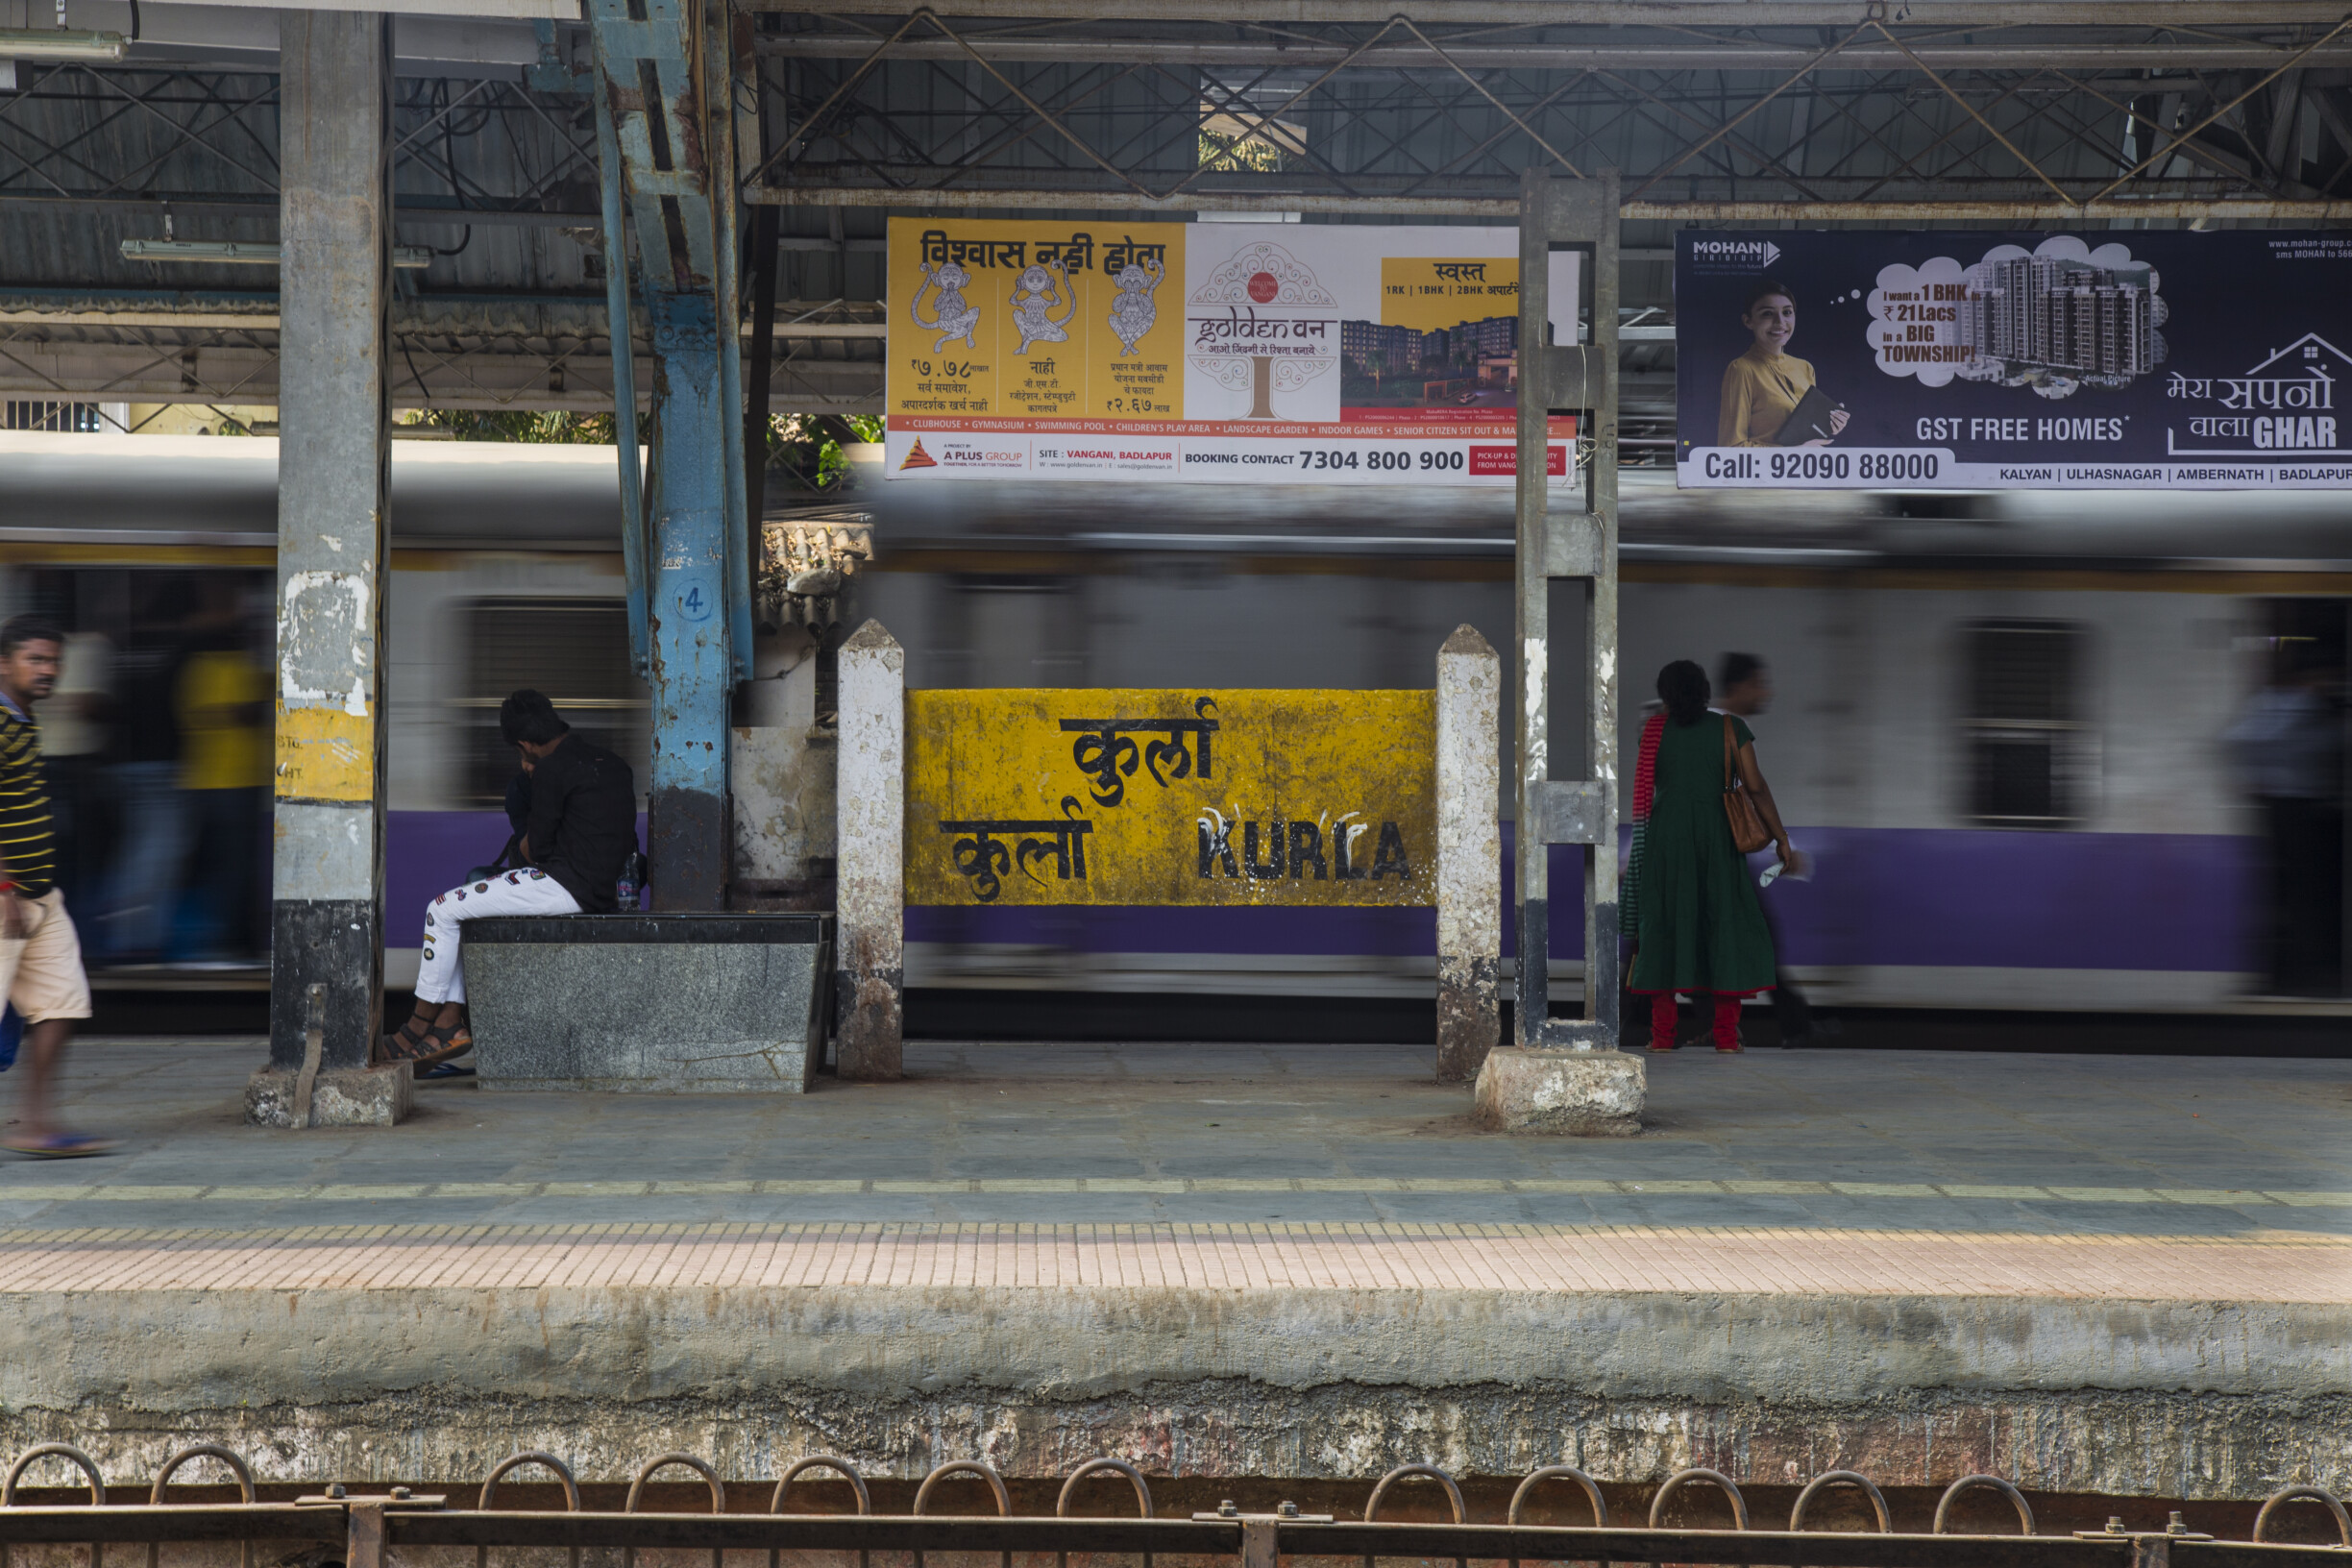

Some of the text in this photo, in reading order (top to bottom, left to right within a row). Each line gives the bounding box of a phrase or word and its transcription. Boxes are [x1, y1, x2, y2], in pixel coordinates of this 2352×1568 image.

[1694, 241, 1762, 254] MOHAN
[2268, 239, 2352, 248] www.mohan-group.c
[920, 230, 1026, 268] विश्वास
[1103, 235, 1165, 276] होता
[2294, 250, 2325, 258] MOHAN
[2338, 250, 2352, 258] 566
[1433, 263, 1487, 282] स्वस्त
[1386, 285, 1405, 294] 1RK
[1418, 285, 1444, 294] 1BHK
[1457, 285, 1483, 294] 2BHK
[1883, 283, 1981, 302] I want a 1 BHK in
[1898, 304, 1916, 322] 21
[1919, 304, 1957, 322] Lacs
[1291, 320, 1337, 338] वन
[1883, 325, 1935, 342] in a BIG
[1208, 343, 1231, 355] आओ
[1260, 343, 1267, 355] से
[1269, 344, 1291, 355] रिश्ता
[1883, 345, 1975, 362] TOWNSHIP!
[1029, 357, 1056, 375] नाही
[918, 380, 932, 393] सर्व
[2167, 364, 2336, 409] मेरा सपनों
[948, 398, 967, 411] खर्च
[968, 399, 989, 411] नाही
[913, 419, 962, 429] CLUBHOUSE
[971, 420, 1024, 429] GYMNASIUM
[1035, 421, 1082, 430] SWIMMING
[1084, 422, 1106, 431] POOL
[1115, 423, 1164, 432] CHILDREN'S
[1165, 424, 1187, 432] PLAY
[1188, 424, 1211, 432] AREA
[1223, 425, 1271, 433] LANDSCAPE
[1273, 426, 1308, 434] GARDEN
[1318, 426, 1352, 435] INDOOR
[1354, 426, 1384, 435] GAMES
[1394, 426, 1424, 435] SENIOR
[1426, 426, 1458, 435] CITIZEN
[1459, 427, 1473, 435] SIT
[1474, 427, 1490, 435] OUT
[1493, 427, 1501, 435] &
[1917, 417, 1963, 440] GST
[1971, 418, 2029, 441] FREE
[2189, 416, 2337, 449] वाला GHAR
[943, 452, 1022, 461] A PLUS GROUP
[1039, 450, 1172, 460] SITE VANGANI, BADLAPUR
[1185, 451, 1464, 470] BOOKING CONTACT 7304 800 900
[1705, 453, 1939, 479] Call: 92090 88000
[1999, 469, 2352, 480] KALYAN ULHASNAGAR AMBERNATH BADLAPUR
[685, 587, 703, 613] 4
[1058, 696, 1220, 808] कुर्ला
[938, 795, 1093, 902] कुर्ला
[1197, 818, 1412, 881] KURLA
